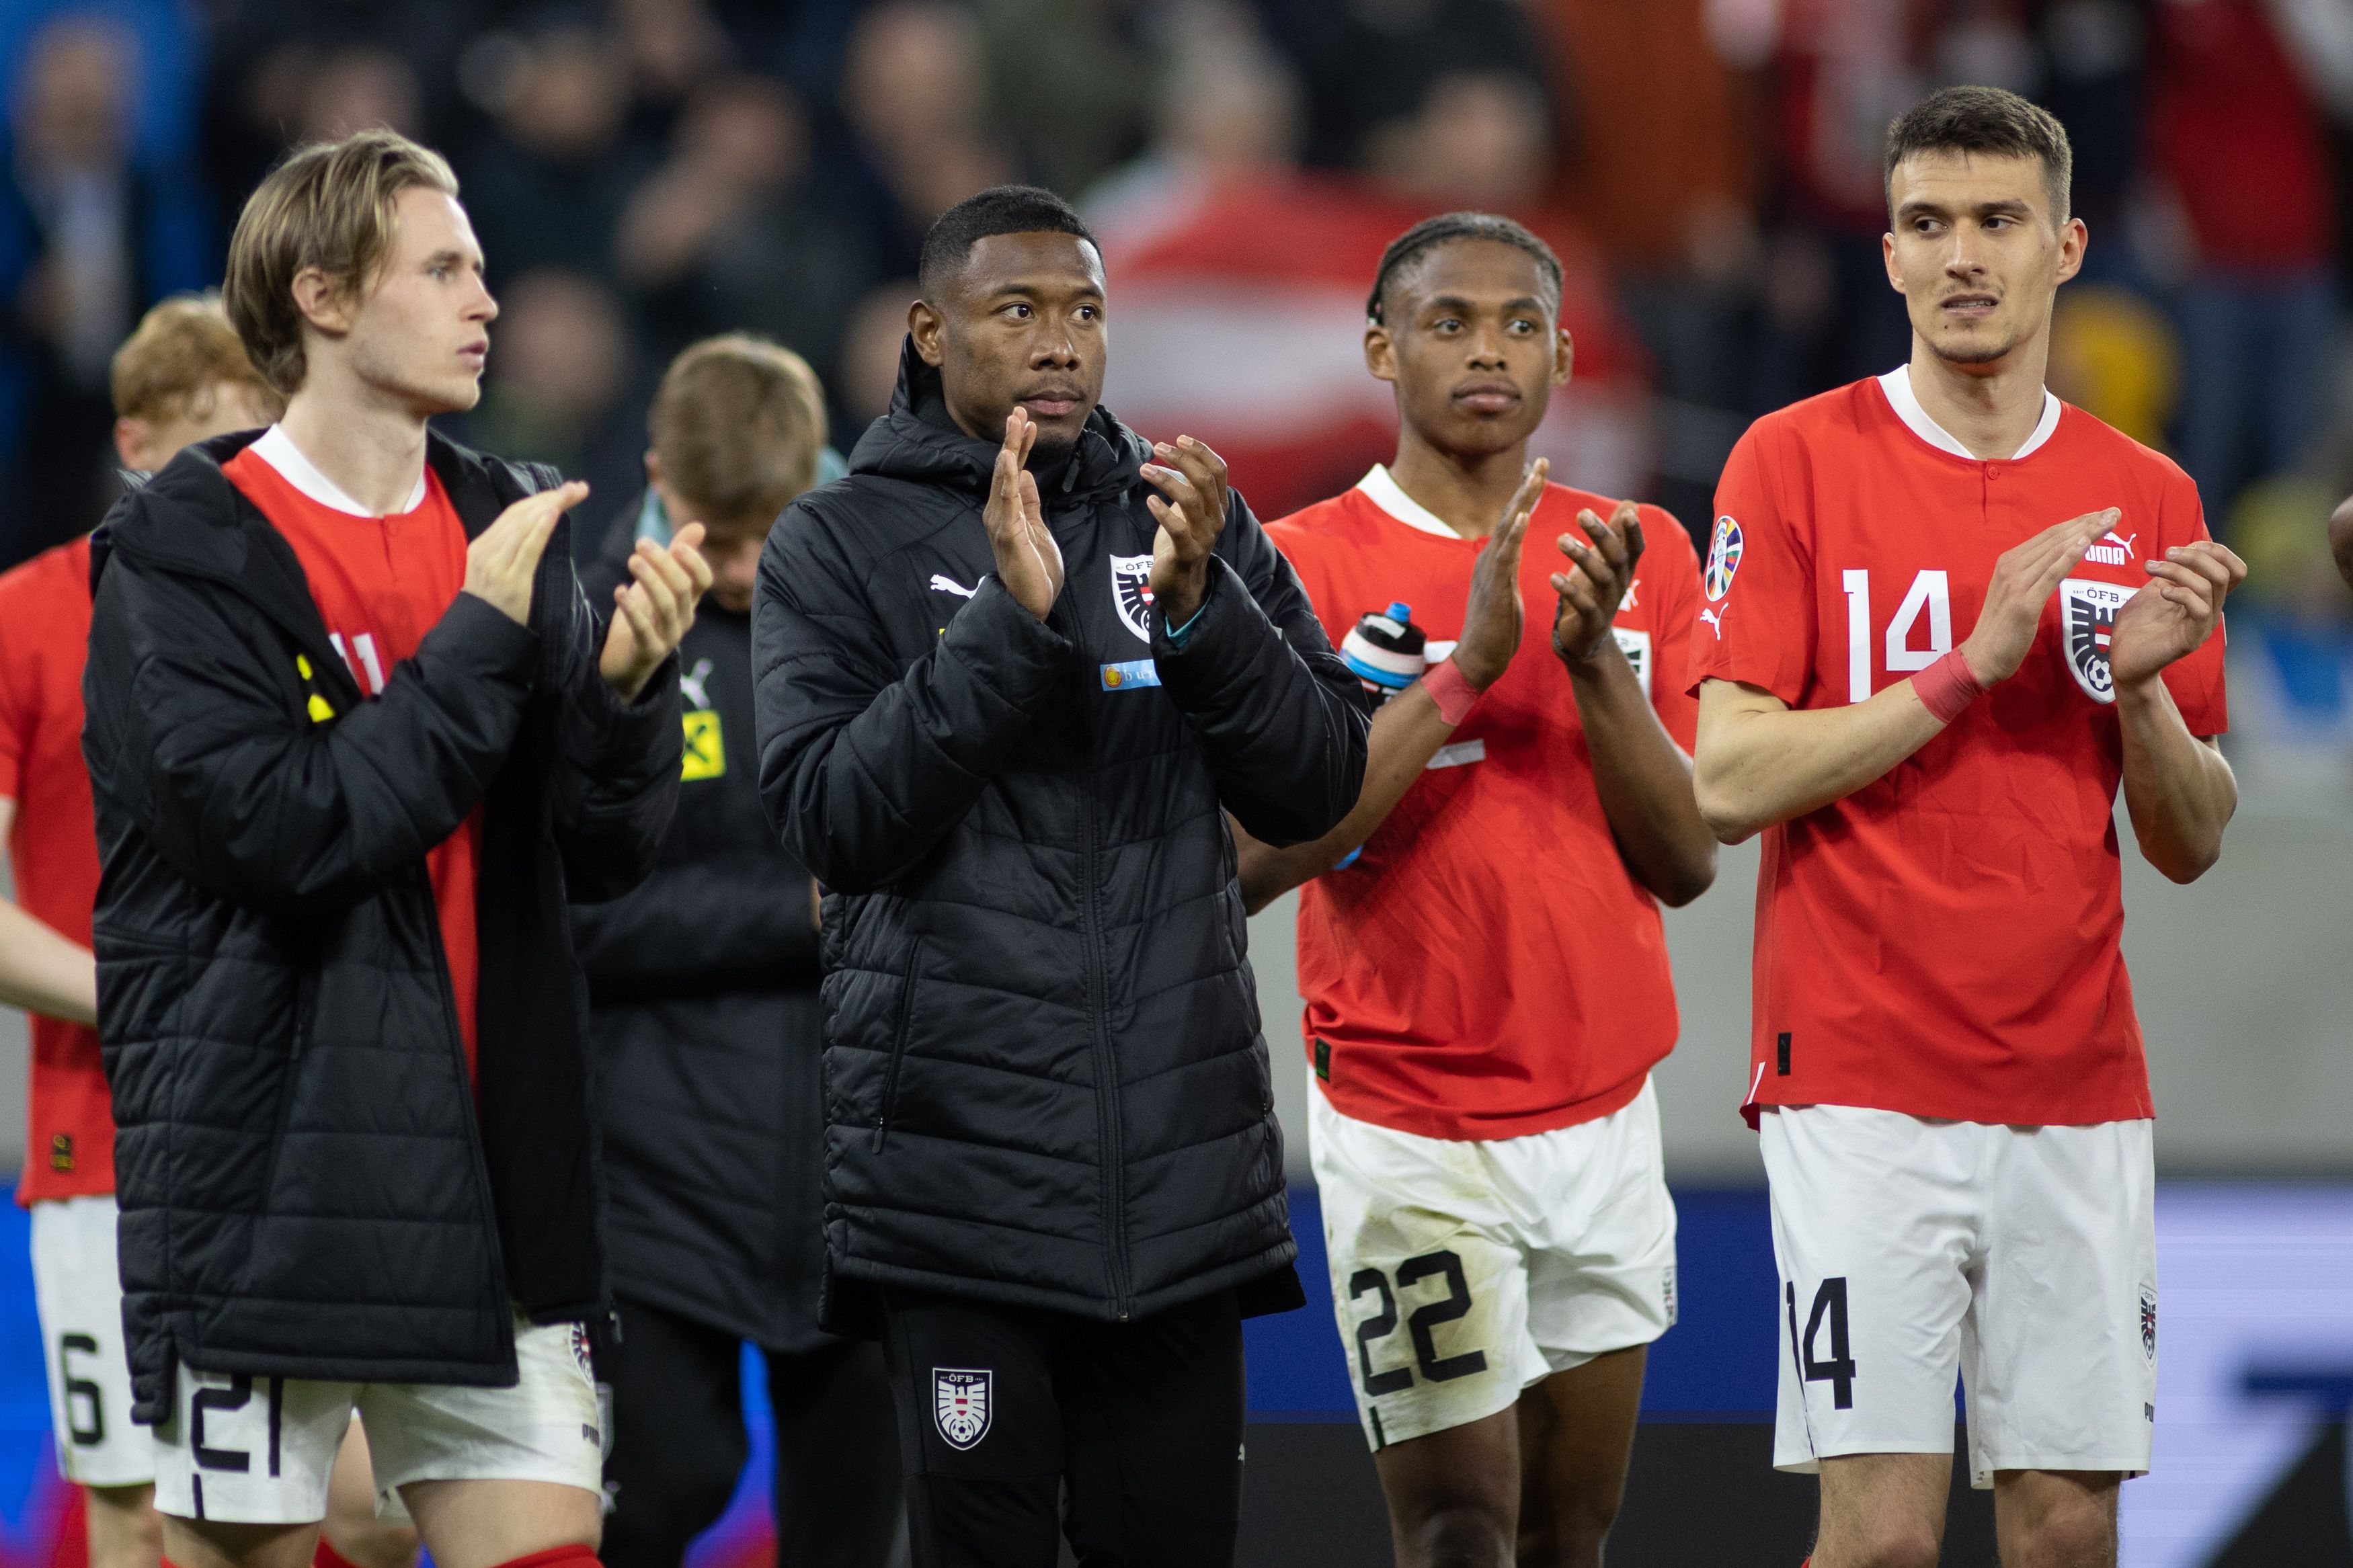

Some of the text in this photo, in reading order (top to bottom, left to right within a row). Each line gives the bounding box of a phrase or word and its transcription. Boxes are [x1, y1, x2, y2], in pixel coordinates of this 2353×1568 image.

[2085, 545, 2125, 565] UMA
[2087, 587, 2119, 603] ÖFB
[1123, 667, 1154, 682] bur
[1843, 569, 1952, 703] 14
[1349, 1249, 1487, 1397] 22
[1786, 1276, 1856, 1412] 14
[63, 1333, 104, 1445] 6
[190, 1373, 282, 1479] 21
[949, 1373, 973, 1383] ÖFB
